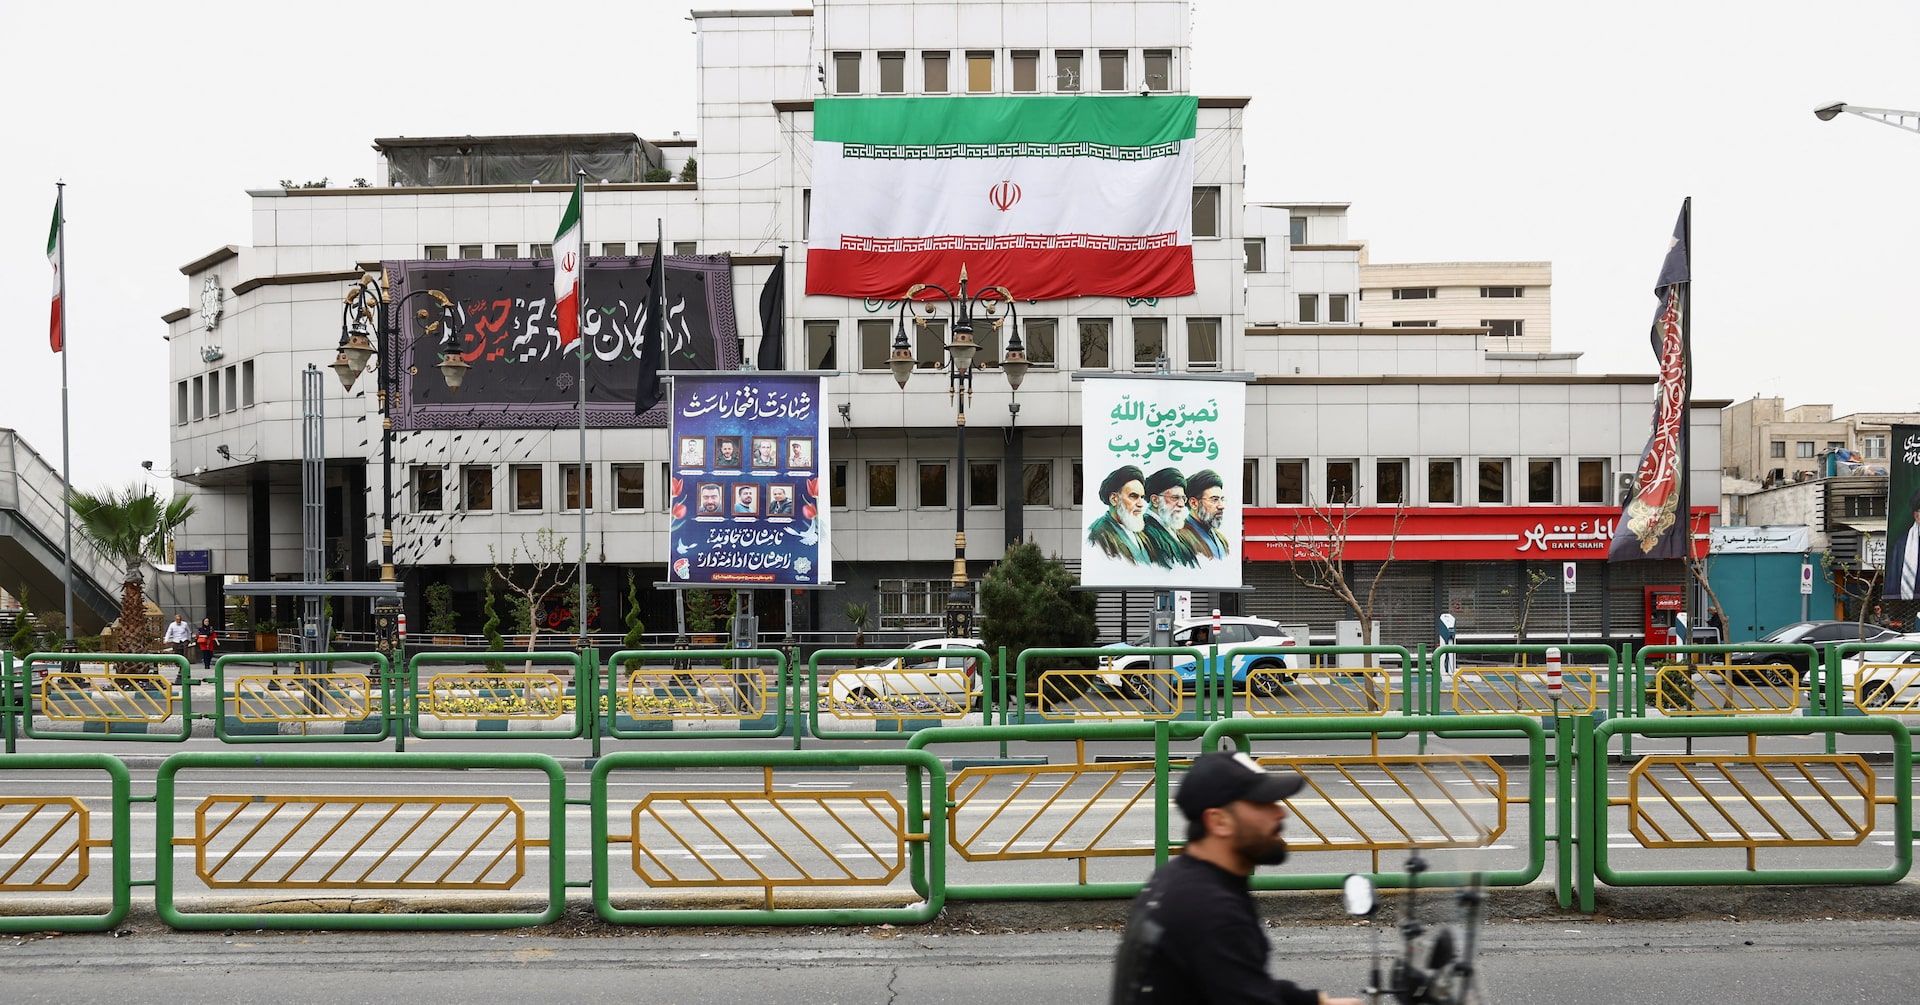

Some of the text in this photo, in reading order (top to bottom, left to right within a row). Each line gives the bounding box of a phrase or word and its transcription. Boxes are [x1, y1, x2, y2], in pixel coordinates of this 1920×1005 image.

[460, 297, 512, 362] حسین
[1516, 517, 1615, 551] انک شهر
